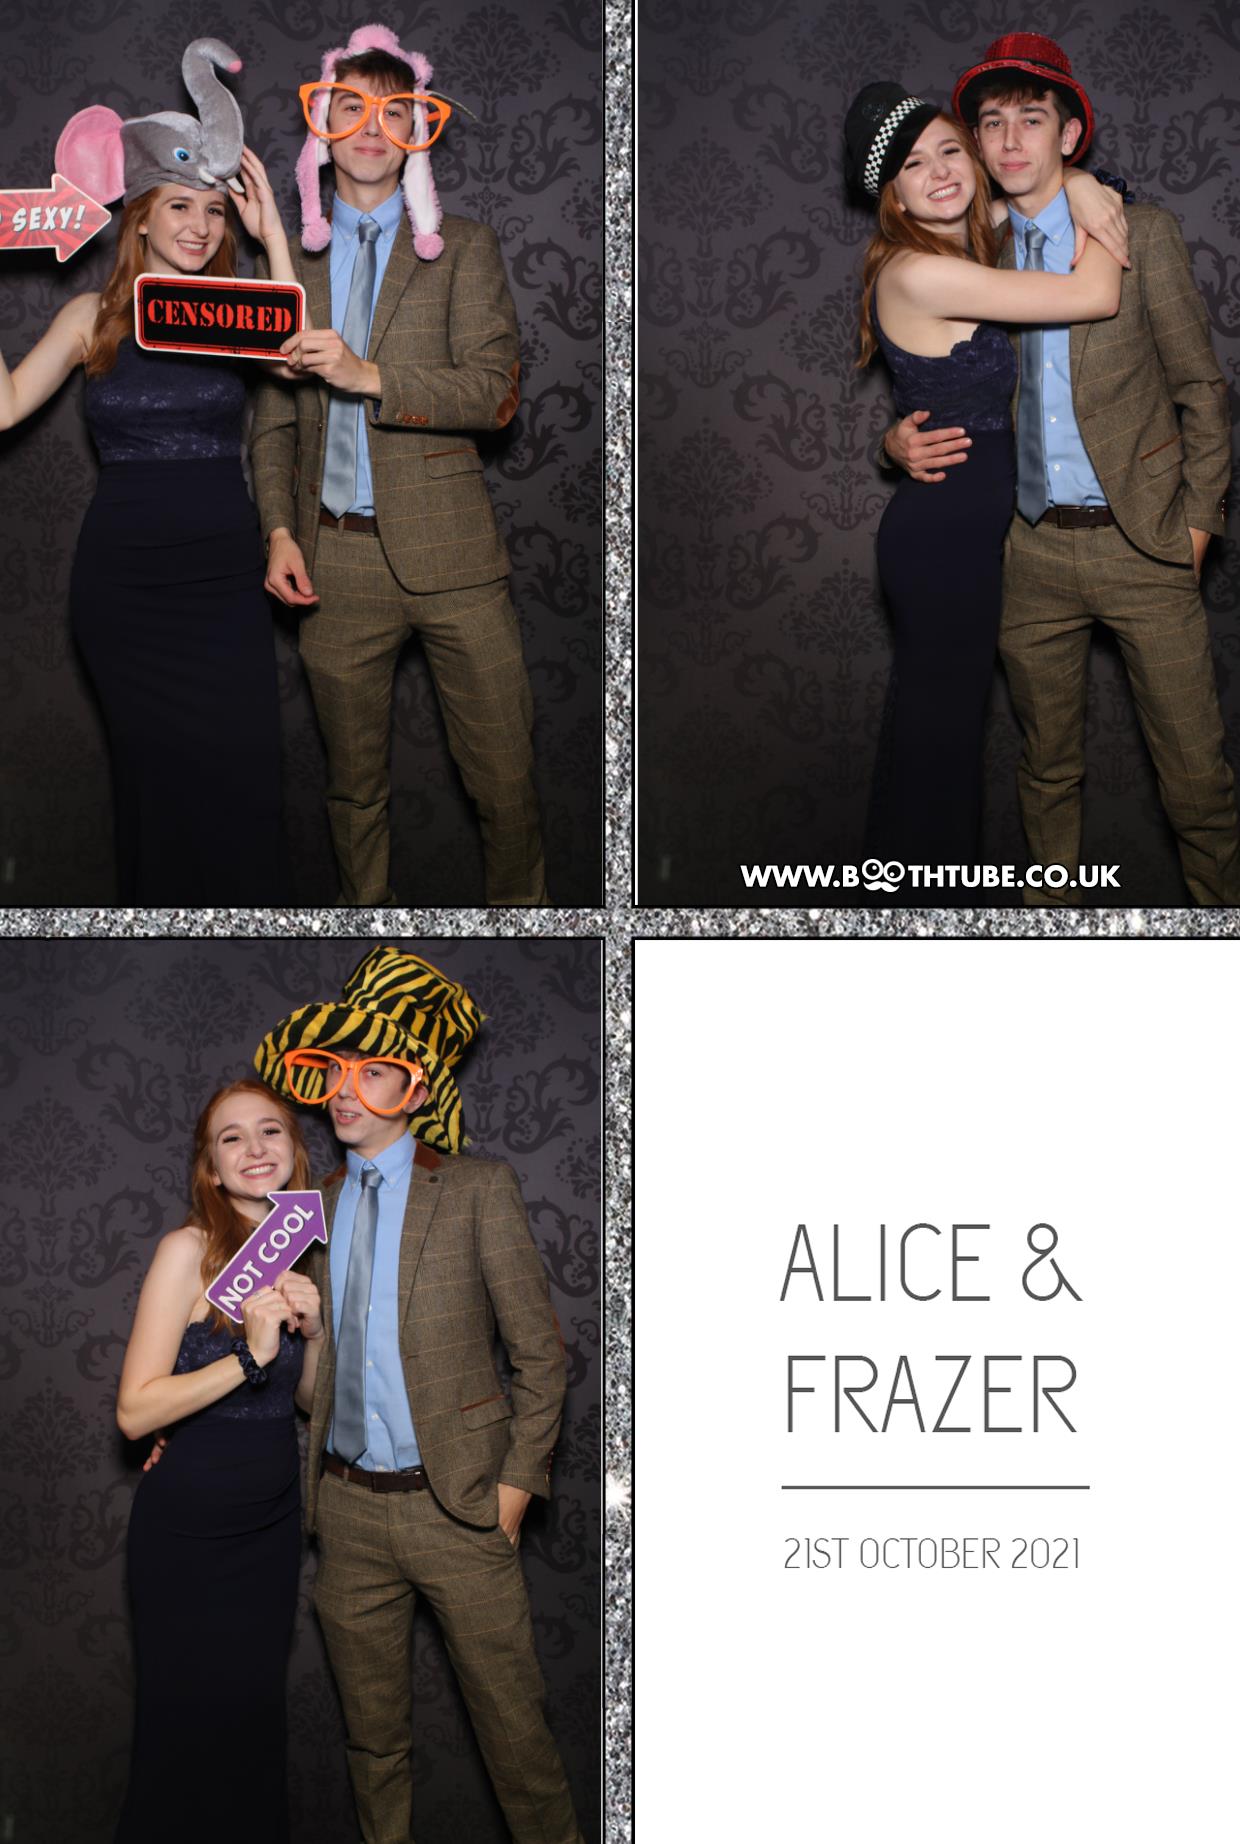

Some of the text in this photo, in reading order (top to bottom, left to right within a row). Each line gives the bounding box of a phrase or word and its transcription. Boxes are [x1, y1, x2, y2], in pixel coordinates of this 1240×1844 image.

[12, 204, 86, 232] SEXY!
[147, 299, 292, 333] CENSORED
[218, 1204, 315, 1311] NOT COOL
